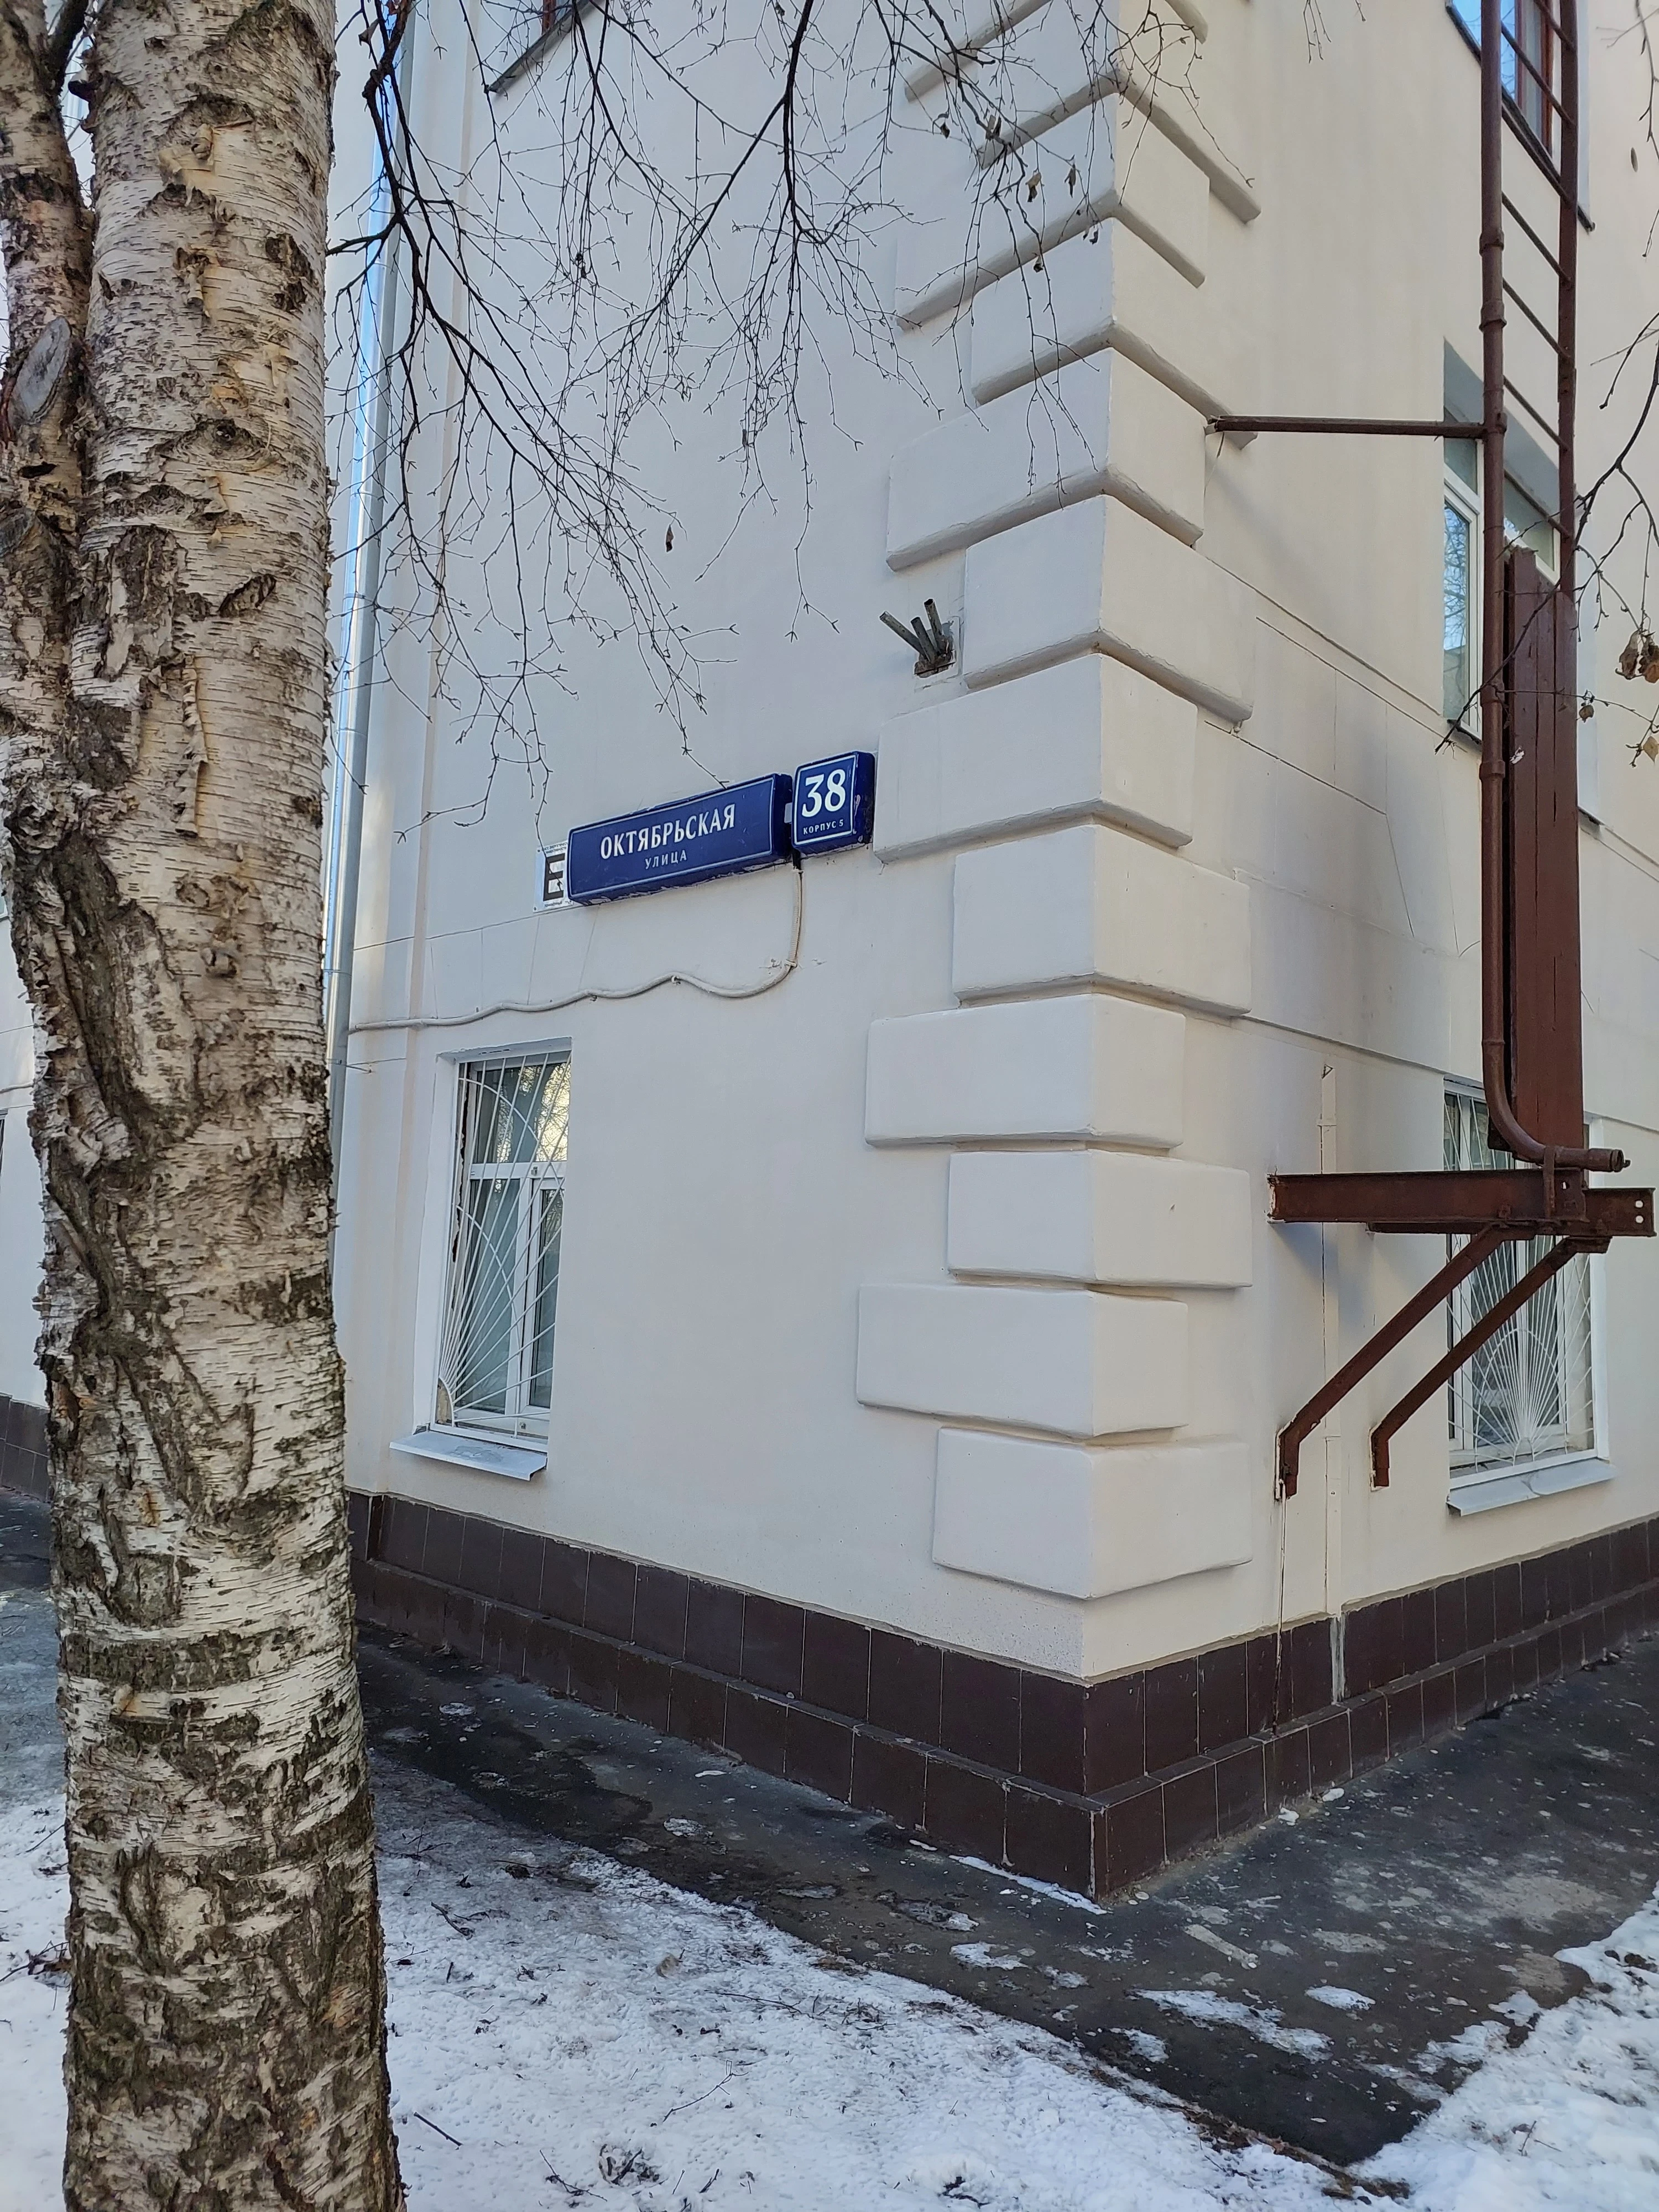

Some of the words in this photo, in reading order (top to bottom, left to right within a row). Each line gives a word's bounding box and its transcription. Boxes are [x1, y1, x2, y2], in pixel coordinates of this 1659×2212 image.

[802, 769, 846, 817] 38
[601, 804, 735, 859] ОКТЯБРЬСКАЯ
[803, 821, 836, 834] КОРПУС
[645, 850, 687, 870] УЛИЦА
